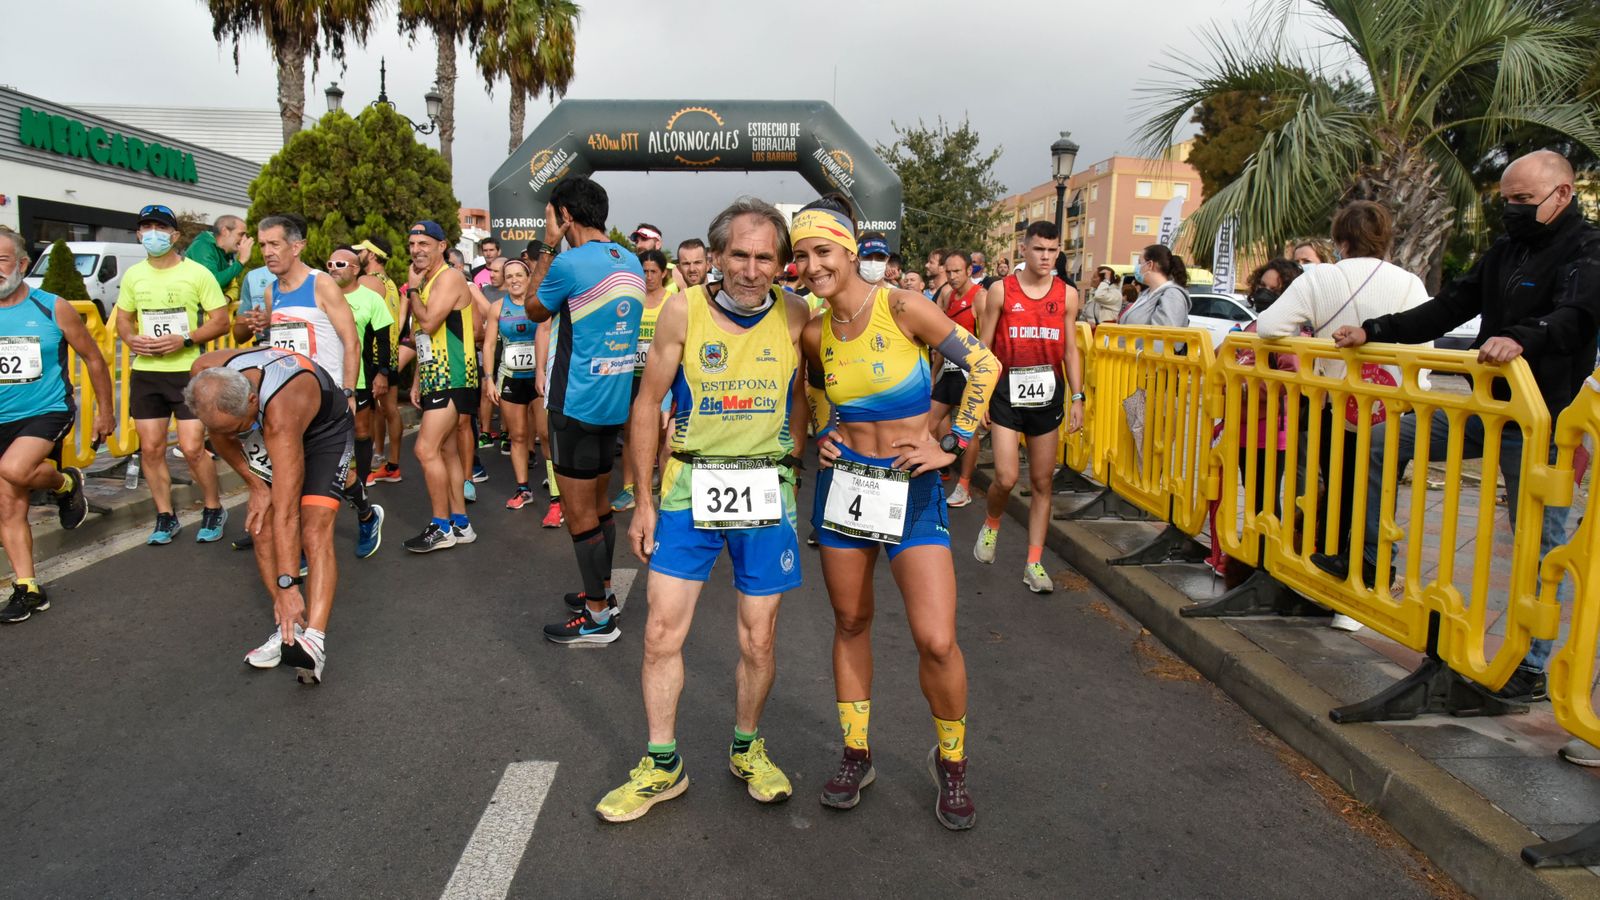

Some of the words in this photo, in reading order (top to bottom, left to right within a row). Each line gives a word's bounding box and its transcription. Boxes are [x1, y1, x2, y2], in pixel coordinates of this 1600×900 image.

[748, 122, 787, 137] ESTRECHO
[790, 122, 800, 137] DE
[20, 106, 199, 184] MERCADONA
[620, 132, 640, 151] BTT
[648, 129, 740, 154] ALCORNOCALES
[751, 137, 796, 151] GIBRALTAR
[751, 151, 765, 162] LOS
[767, 151, 798, 162] BARRIOS
[528, 147, 569, 193] ALCORNOCALES
[812, 147, 856, 189] ALCORNOCALES
[491, 218, 504, 229] LOS
[857, 220, 898, 231] BARRIOS
[500, 228, 537, 241] CÁDIZ
[153, 323, 172, 338] 65
[512, 353, 533, 367] 172
[701, 379, 778, 392] ESTEPONA
[1018, 382, 1045, 399] 244
[699, 395, 754, 414] BigMat
[754, 396, 778, 409] City
[248, 443, 273, 471] 24
[707, 486, 752, 513] 321
[848, 494, 862, 521] 4
